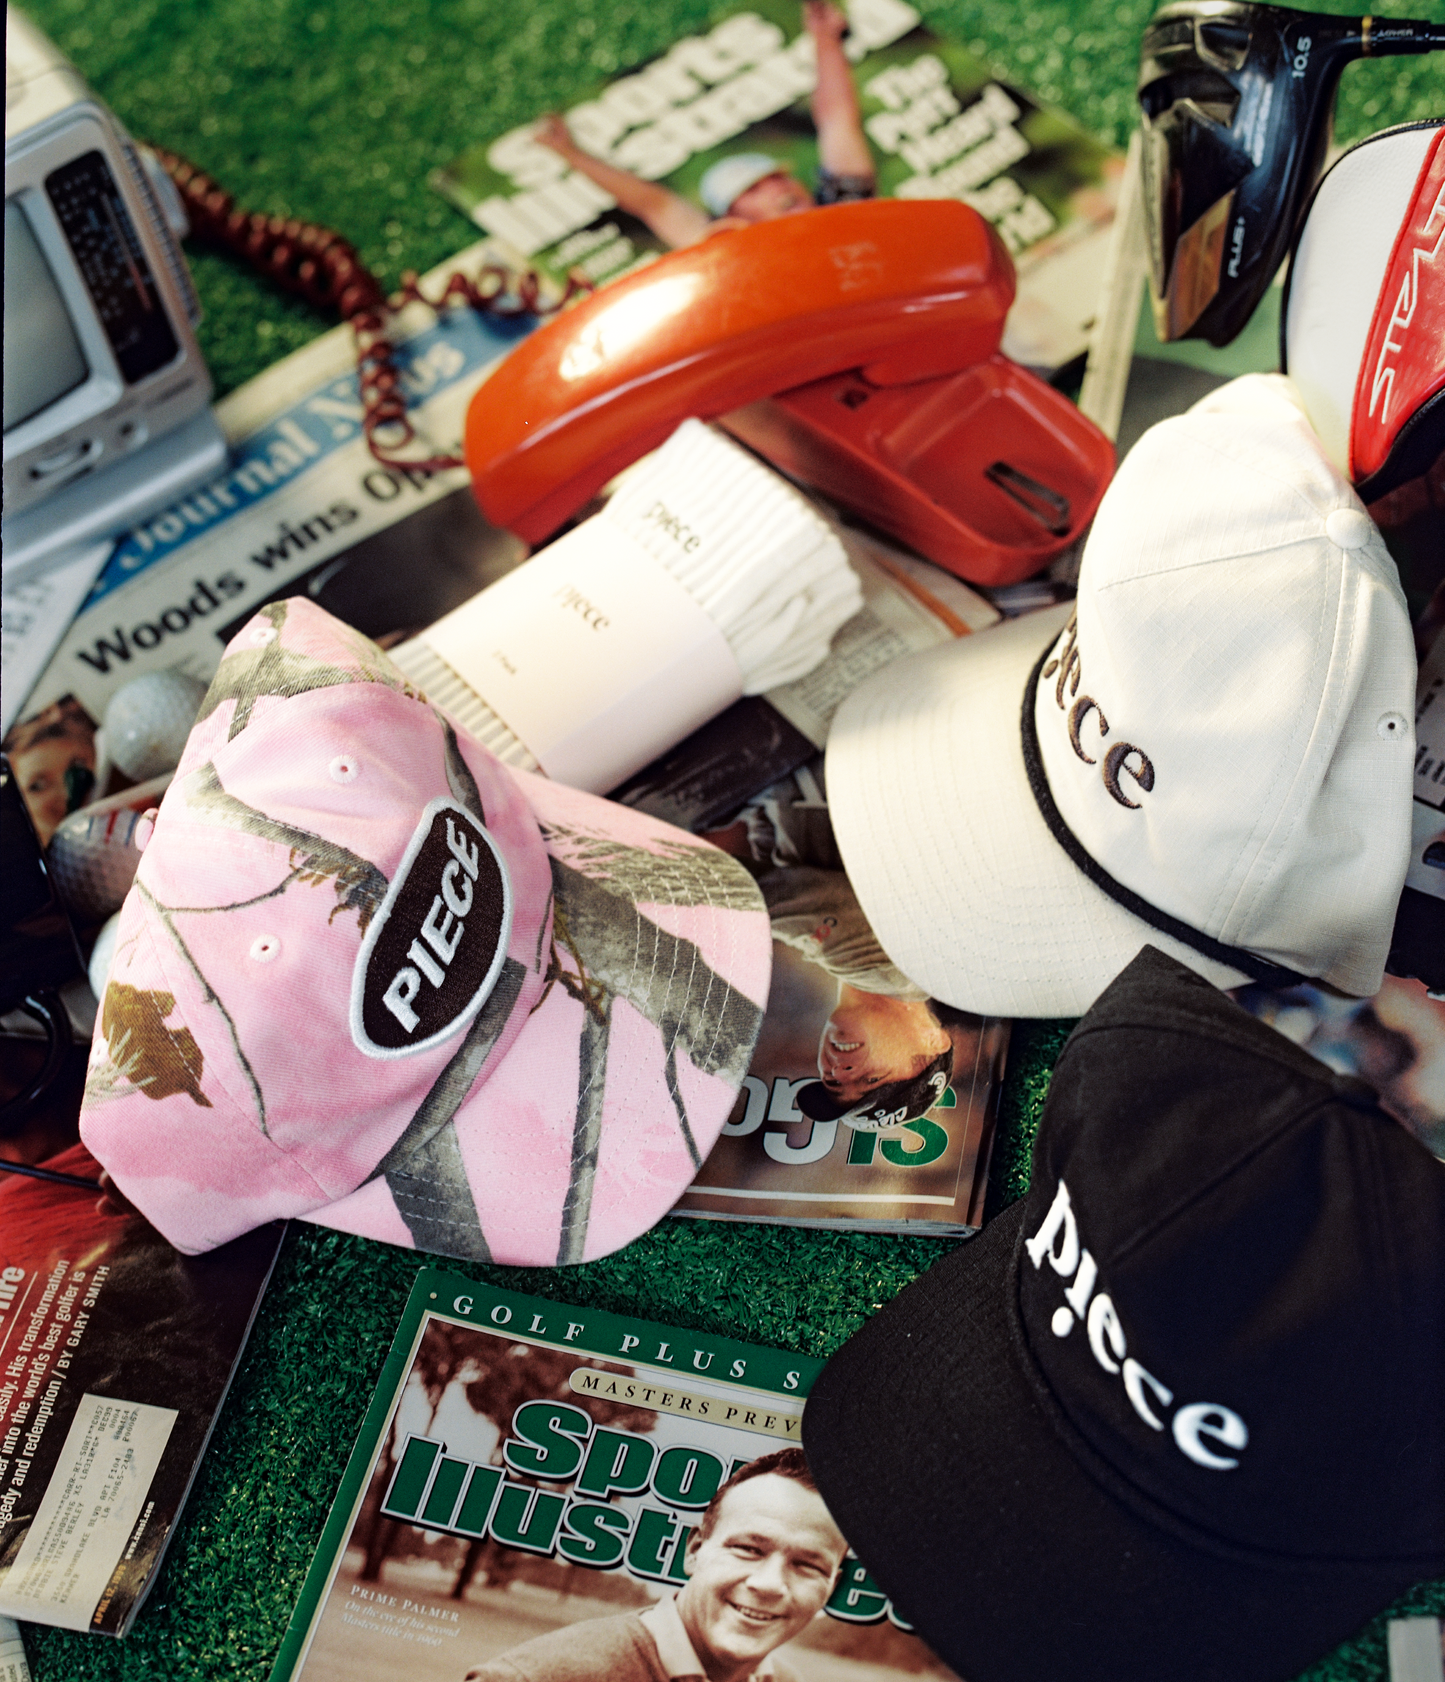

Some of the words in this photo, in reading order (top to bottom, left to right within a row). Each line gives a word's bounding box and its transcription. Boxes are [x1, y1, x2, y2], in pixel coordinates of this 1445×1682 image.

[1291, 35, 1312, 79] 10.5
[1227, 215, 1246, 278] PLUS+
[309, 340, 465, 438] Nws
[77, 568, 246, 675] Woods
[250, 495, 360, 571] wins
[1044, 603, 1155, 809] iece
[382, 817, 481, 1034] PIECE
[68, 1267, 86, 1284] is
[82, 1263, 110, 1308] SMITH
[4, 1351, 29, 1380] His
[17, 1257, 70, 1354] transformation
[55, 1284, 79, 1323] golfer
[1024, 1177, 1249, 1472] piece
[38, 1319, 64, 1352] best
[66, 1310, 90, 1348] GARY
[453, 1293, 587, 1342] GOLF
[618, 1333, 749, 1379] PLUS
[782, 1370, 801, 1391] S
[21, 1351, 51, 1400] world's
[56, 1349, 74, 1370] BY
[9, 1398, 32, 1425] the
[19, 1377, 62, 1458] redemption
[97, 1405, 114, 1432] DEC99
[580, 1374, 712, 1417] MASTERS
[725, 1406, 798, 1433] PREV
[0, 1424, 22, 1456] into
[503, 1399, 752, 1511] Spo
[9, 1456, 32, 1487] and
[51, 1538, 68, 1565] STEVE
[108, 1407, 122, 1429] 0004
[98, 1484, 111, 1501] APT
[107, 1456, 122, 1479] F104
[0, 1487, 22, 1534] agedy
[93, 1597, 110, 1624] APRIL
[105, 1583, 117, 1598] 12,
[111, 1563, 126, 1585] 1999
[350, 1584, 397, 1607] PRIME
[402, 1598, 459, 1624] PALMER
[341, 1612, 379, 1631] Masters
[403, 1631, 414, 1640] in
[344, 1600, 361, 1612] On
[362, 1604, 379, 1617] the
[396, 1614, 410, 1627] of
[410, 1617, 426, 1629] his
[425, 1623, 460, 1638] second
